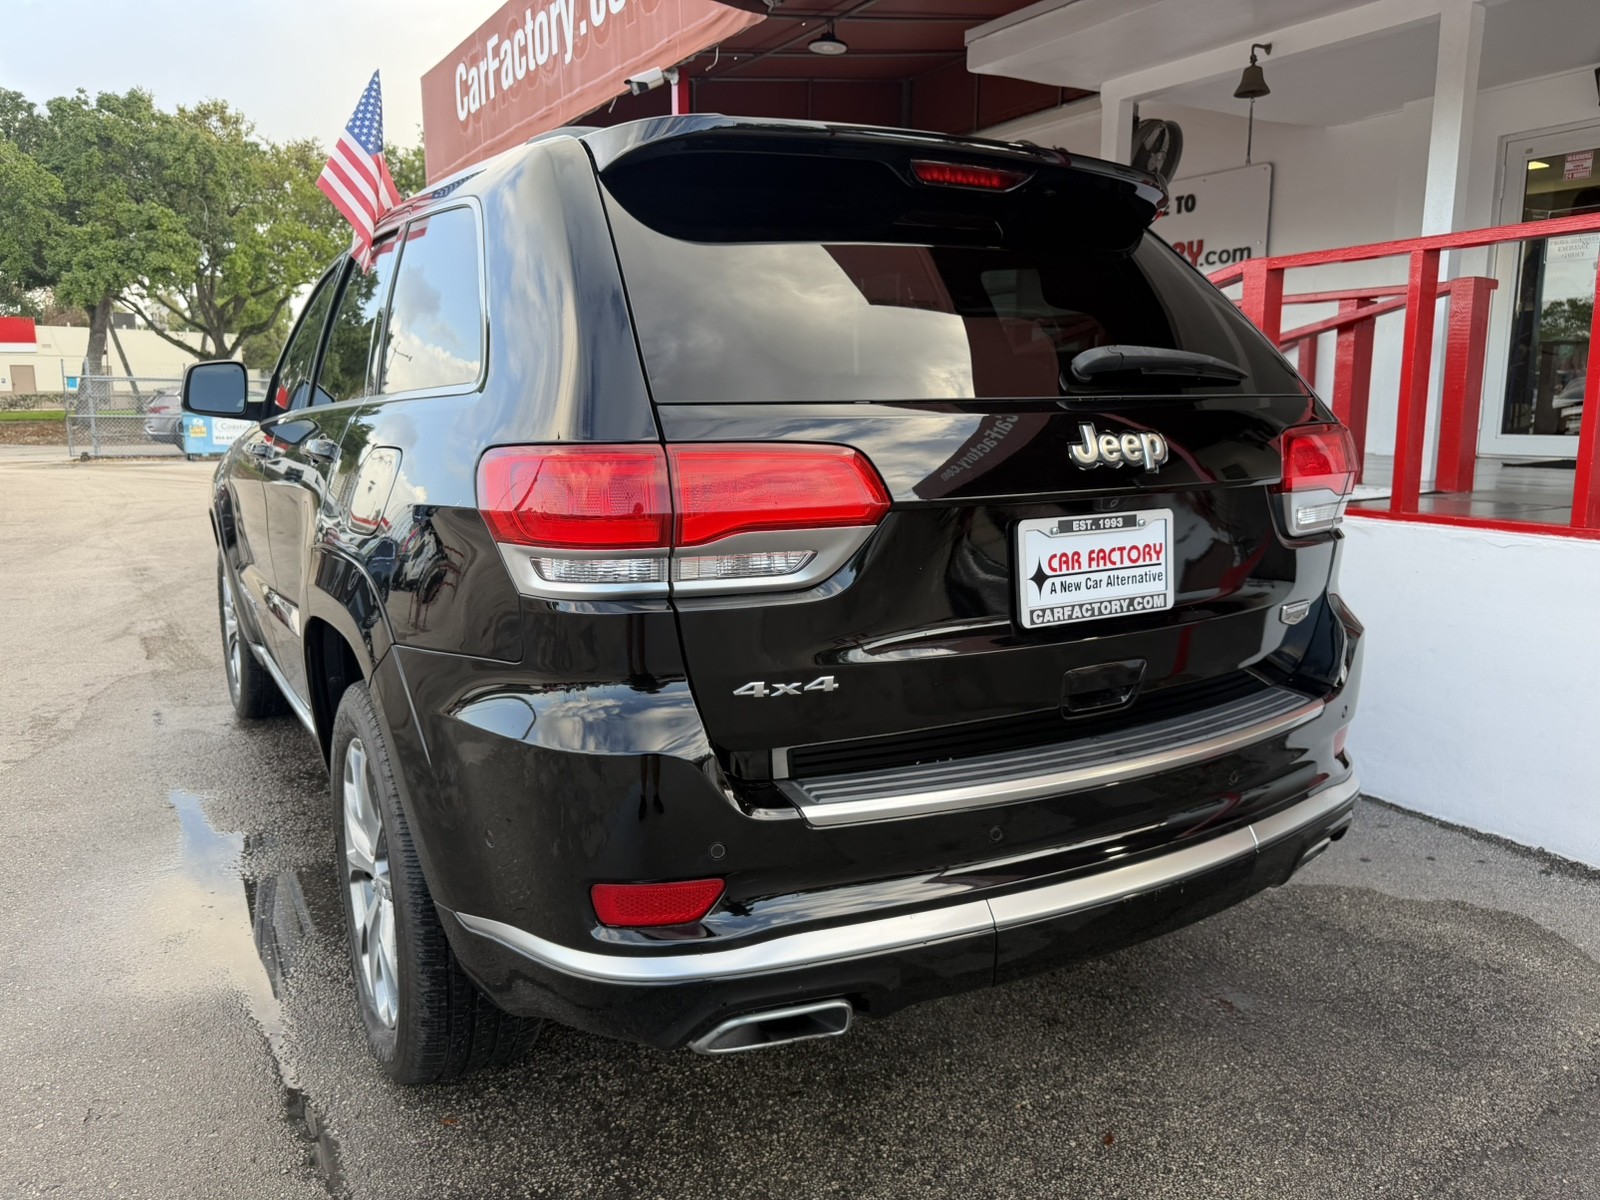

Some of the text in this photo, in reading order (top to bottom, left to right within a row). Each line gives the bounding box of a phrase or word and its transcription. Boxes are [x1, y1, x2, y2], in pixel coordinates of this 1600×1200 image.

[1175, 193, 1196, 214] TO
[1067, 421, 1168, 473] Jeep
[1072, 517, 1124, 531] EST. 1993
[1047, 542, 1163, 573] CAR FACTORY
[1050, 570, 1164, 595] A New Car Alternative
[1032, 595, 1165, 624] CARFACTORY.COM
[732, 675, 839, 698] 4x4
